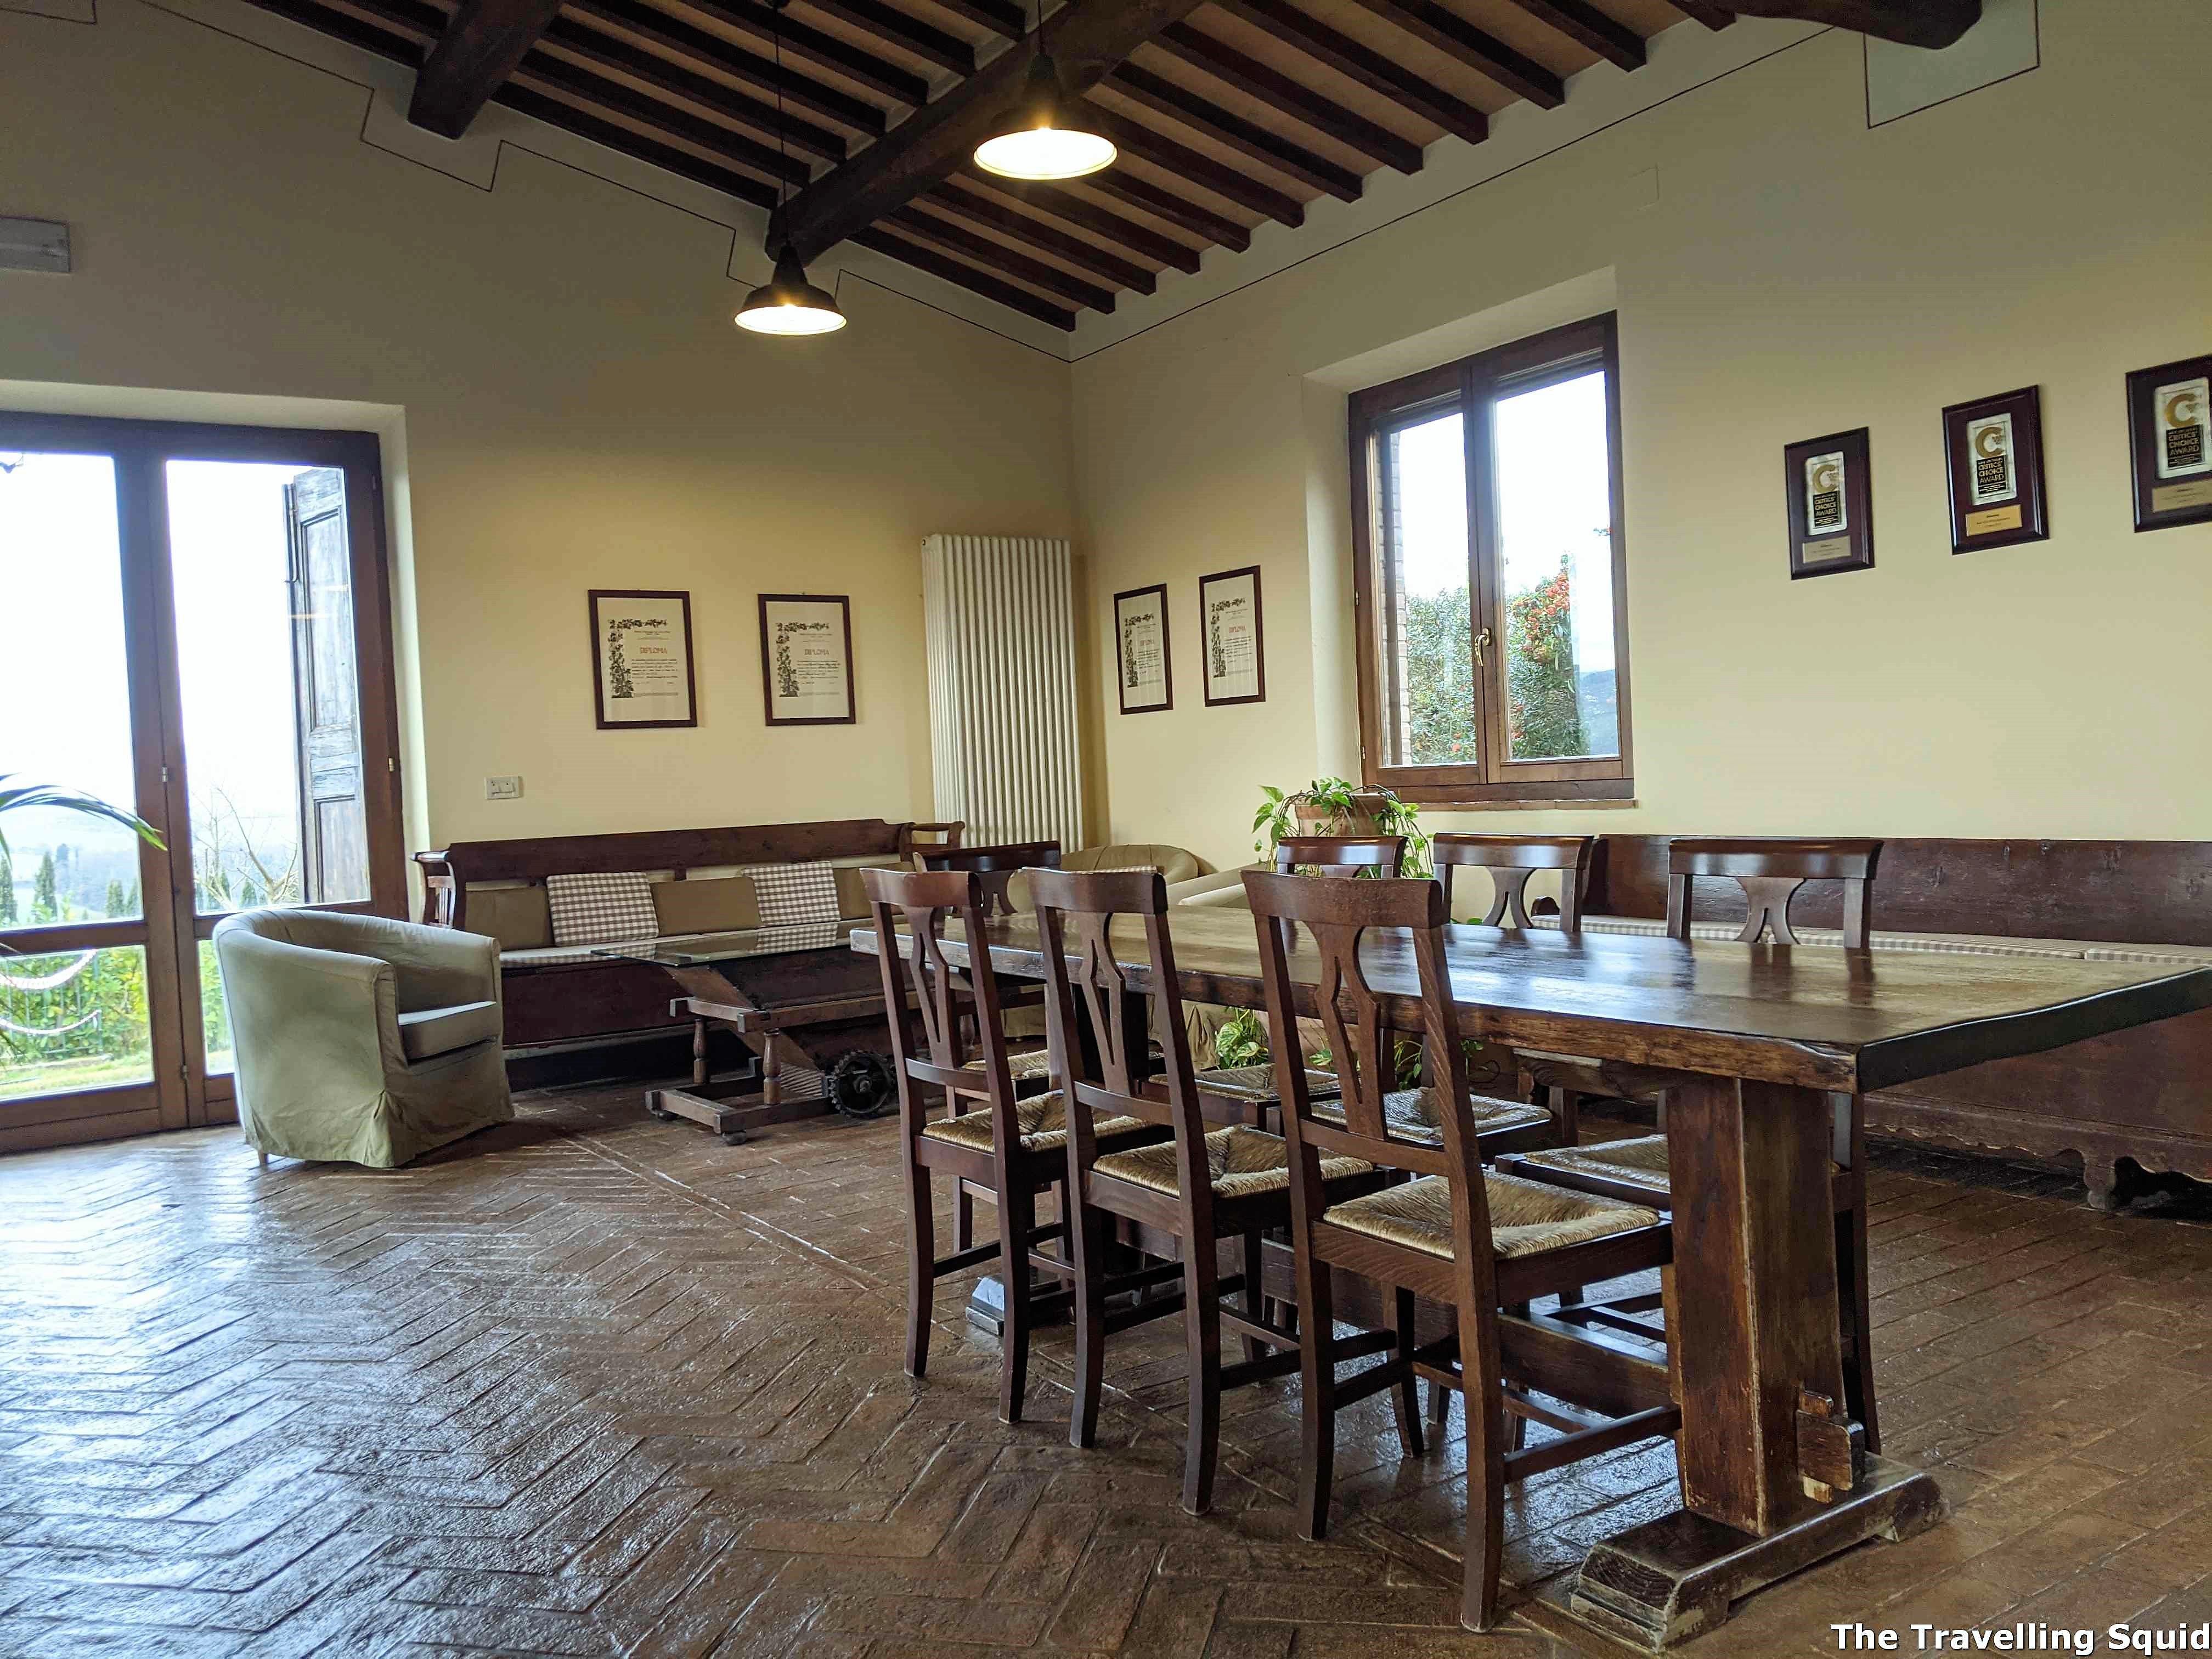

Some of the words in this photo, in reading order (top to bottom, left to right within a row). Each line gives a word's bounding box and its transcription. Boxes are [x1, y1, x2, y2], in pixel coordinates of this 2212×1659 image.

[2169, 445, 2200, 456] AWARD
[1978, 466, 2004, 477] CHOICE
[1979, 473, 2004, 484] AWARD
